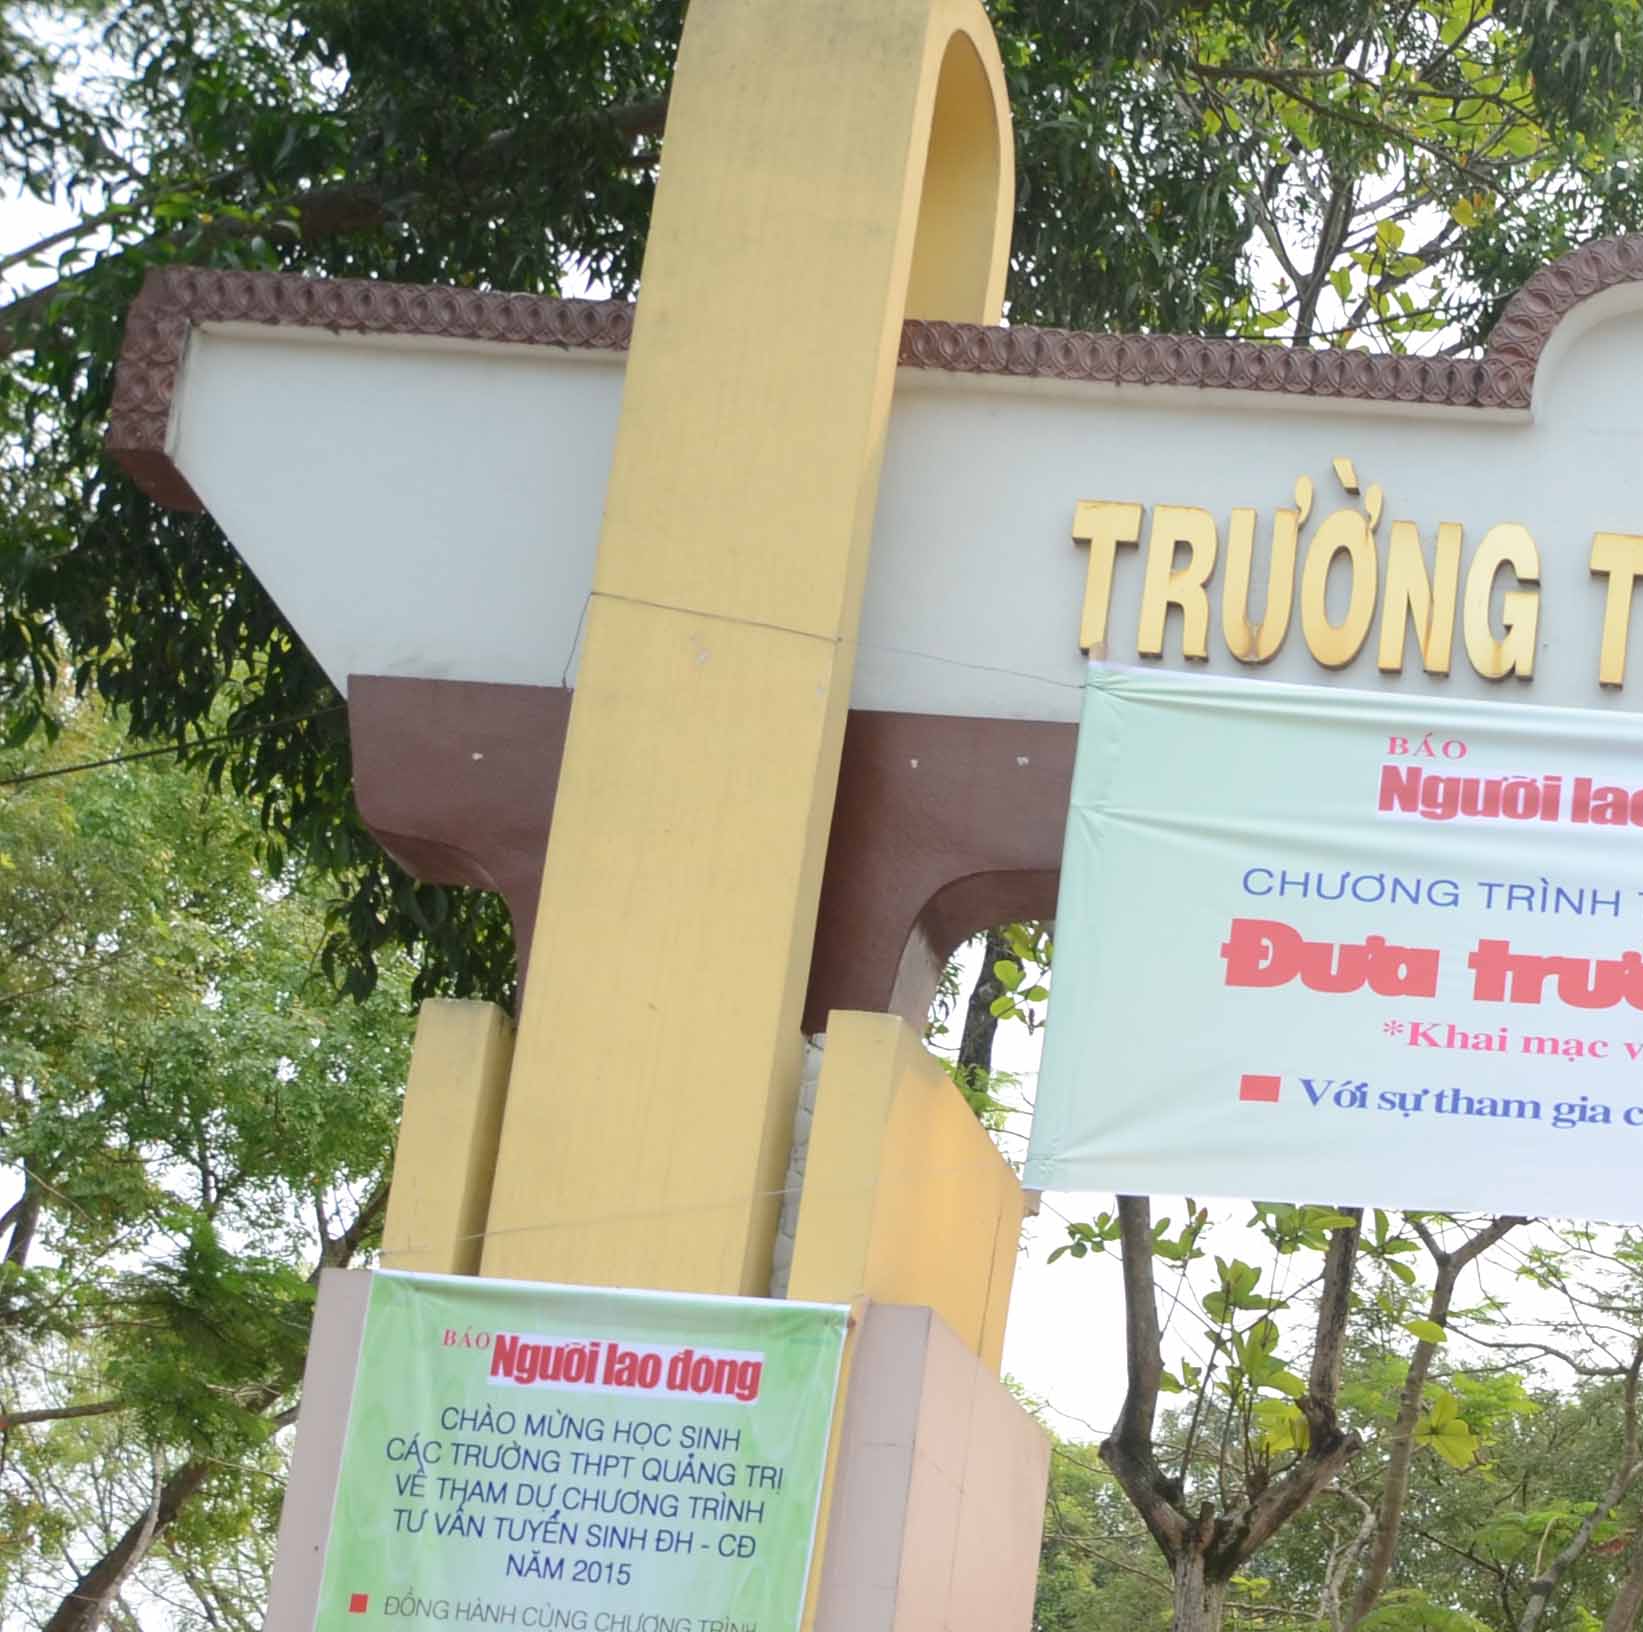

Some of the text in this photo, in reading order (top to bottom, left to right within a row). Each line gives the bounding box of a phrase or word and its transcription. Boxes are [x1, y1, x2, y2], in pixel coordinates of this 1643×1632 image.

[1071, 457, 1541, 684] TRƯỜNG
[1388, 732, 1466, 758] BÁO
[1243, 868, 1458, 906] CHƯƠNG
[1478, 878, 1620, 916] TRÌNH
[1221, 918, 1440, 998] Đưa
[1522, 1036, 1608, 1062] mạc
[1300, 1079, 1368, 1108] Với
[1378, 1088, 1430, 1117] sự
[1434, 1088, 1540, 1118] tham
[1552, 1096, 1610, 1128] gia
[443, 1327, 490, 1348] BÁO
[603, 1344, 660, 1390] lao
[442, 1404, 740, 1451] CHÀO MỪNG HỌC SINH
[387, 1434, 783, 1493] CÁC TRƯỜNG THPT QUẢNG TRỊ
[395, 1462, 764, 1523] VỀ THAM DỰ CHƯƠNG TRÌNH
[394, 1509, 428, 1532] TƯ
[436, 1508, 485, 1538] VẤN
[496, 1510, 578, 1544] TUYỂN
[586, 1524, 647, 1550] SINH
[656, 1530, 693, 1554] ĐH
[718, 1534, 756, 1558] CĐ
[506, 1554, 631, 1585] NĂM 2015
